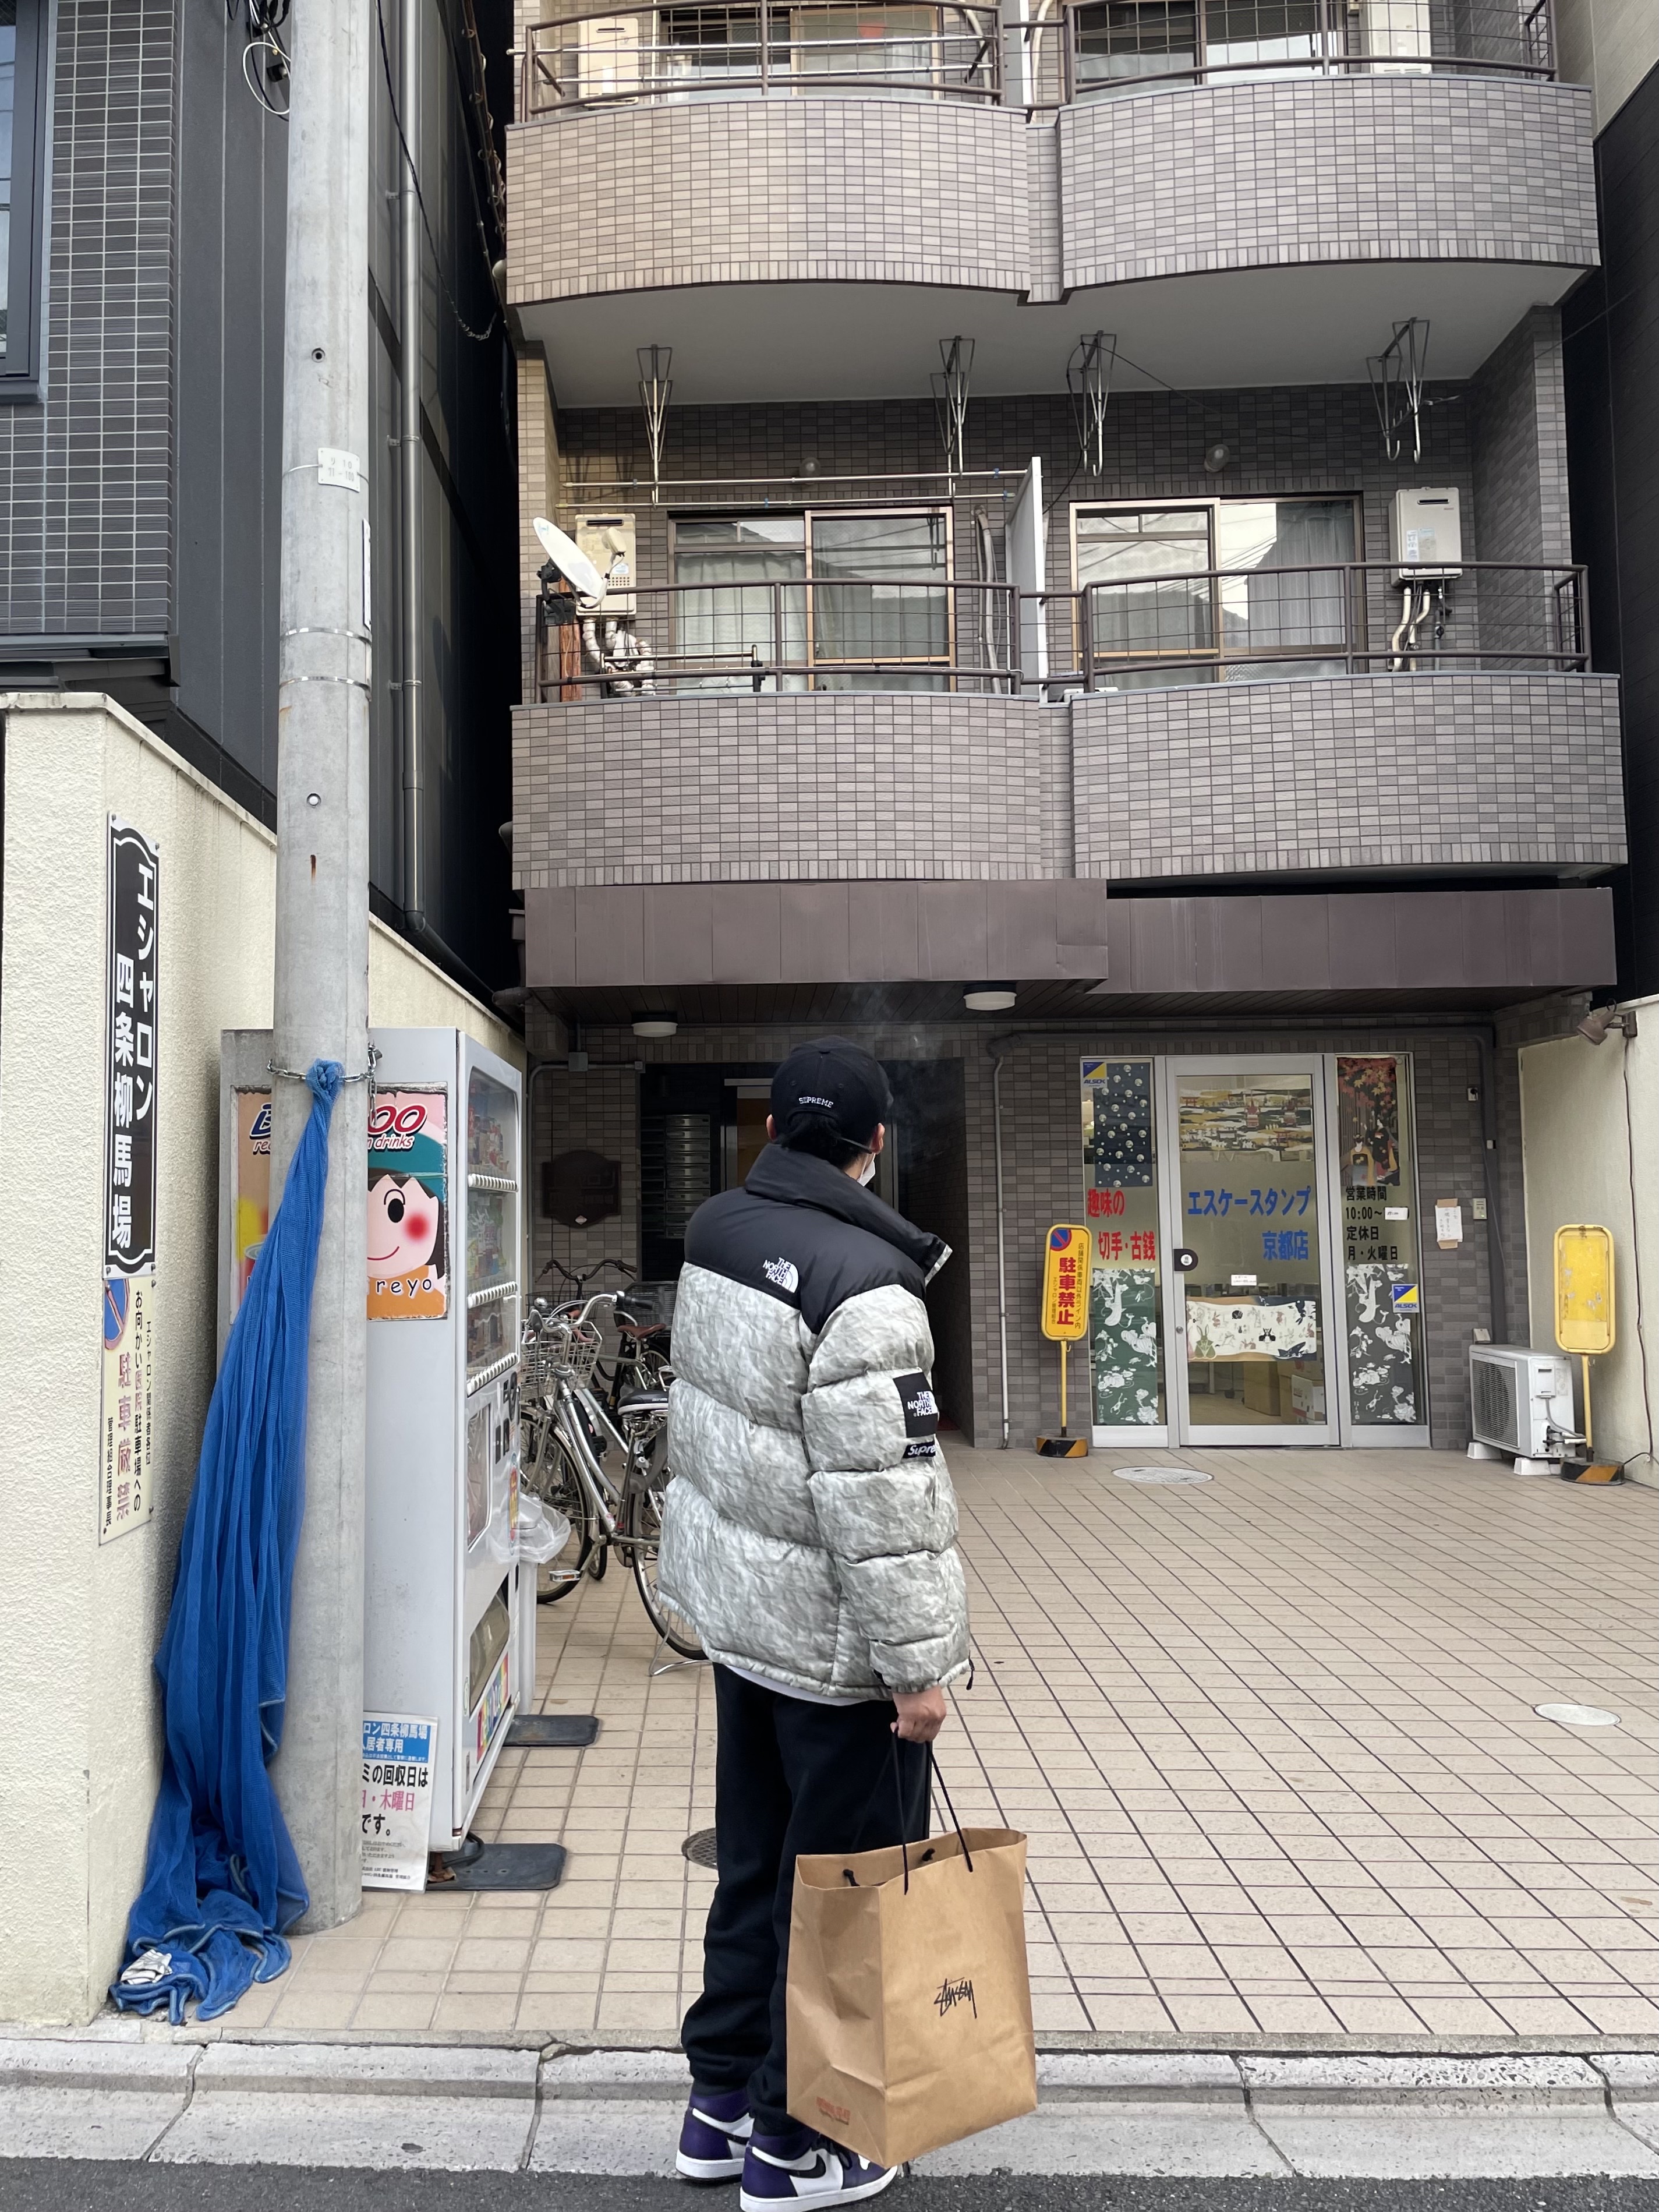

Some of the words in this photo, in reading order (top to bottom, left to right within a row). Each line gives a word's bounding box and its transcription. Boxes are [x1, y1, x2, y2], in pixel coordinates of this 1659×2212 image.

[343, 460, 352, 469] 10
[137, 863, 154, 1121] エシャロン
[112, 952, 135, 1250] 四条柳馬場
[798, 1096, 834, 1108] SUPREME
[375, 1135, 413, 1149] drinks
[1188, 1185, 1311, 1217] エスケースタンプ
[1346, 1186, 1387, 1201] 営業時間
[1088, 1188, 1124, 1218] 趣味の
[1346, 1226, 1379, 1241] 定休日
[1098, 1231, 1155, 1260] 切手・古銭
[1262, 1229, 1308, 1260] 京都店
[1348, 1245, 1398, 1260] 月・火曜日
[762, 1260, 788, 1280] NORTH
[777, 1257, 792, 1270] THE
[765, 1270, 784, 1285] FACE
[1057, 1257, 1077, 1325] 駐車禁止
[917, 1391, 930, 1400] THE
[907, 1399, 931, 1410] NORTH
[916, 1407, 932, 1417] FACE
[116, 1351, 132, 1521] 駐車厳禁
[362, 1814, 391, 1836] です。
